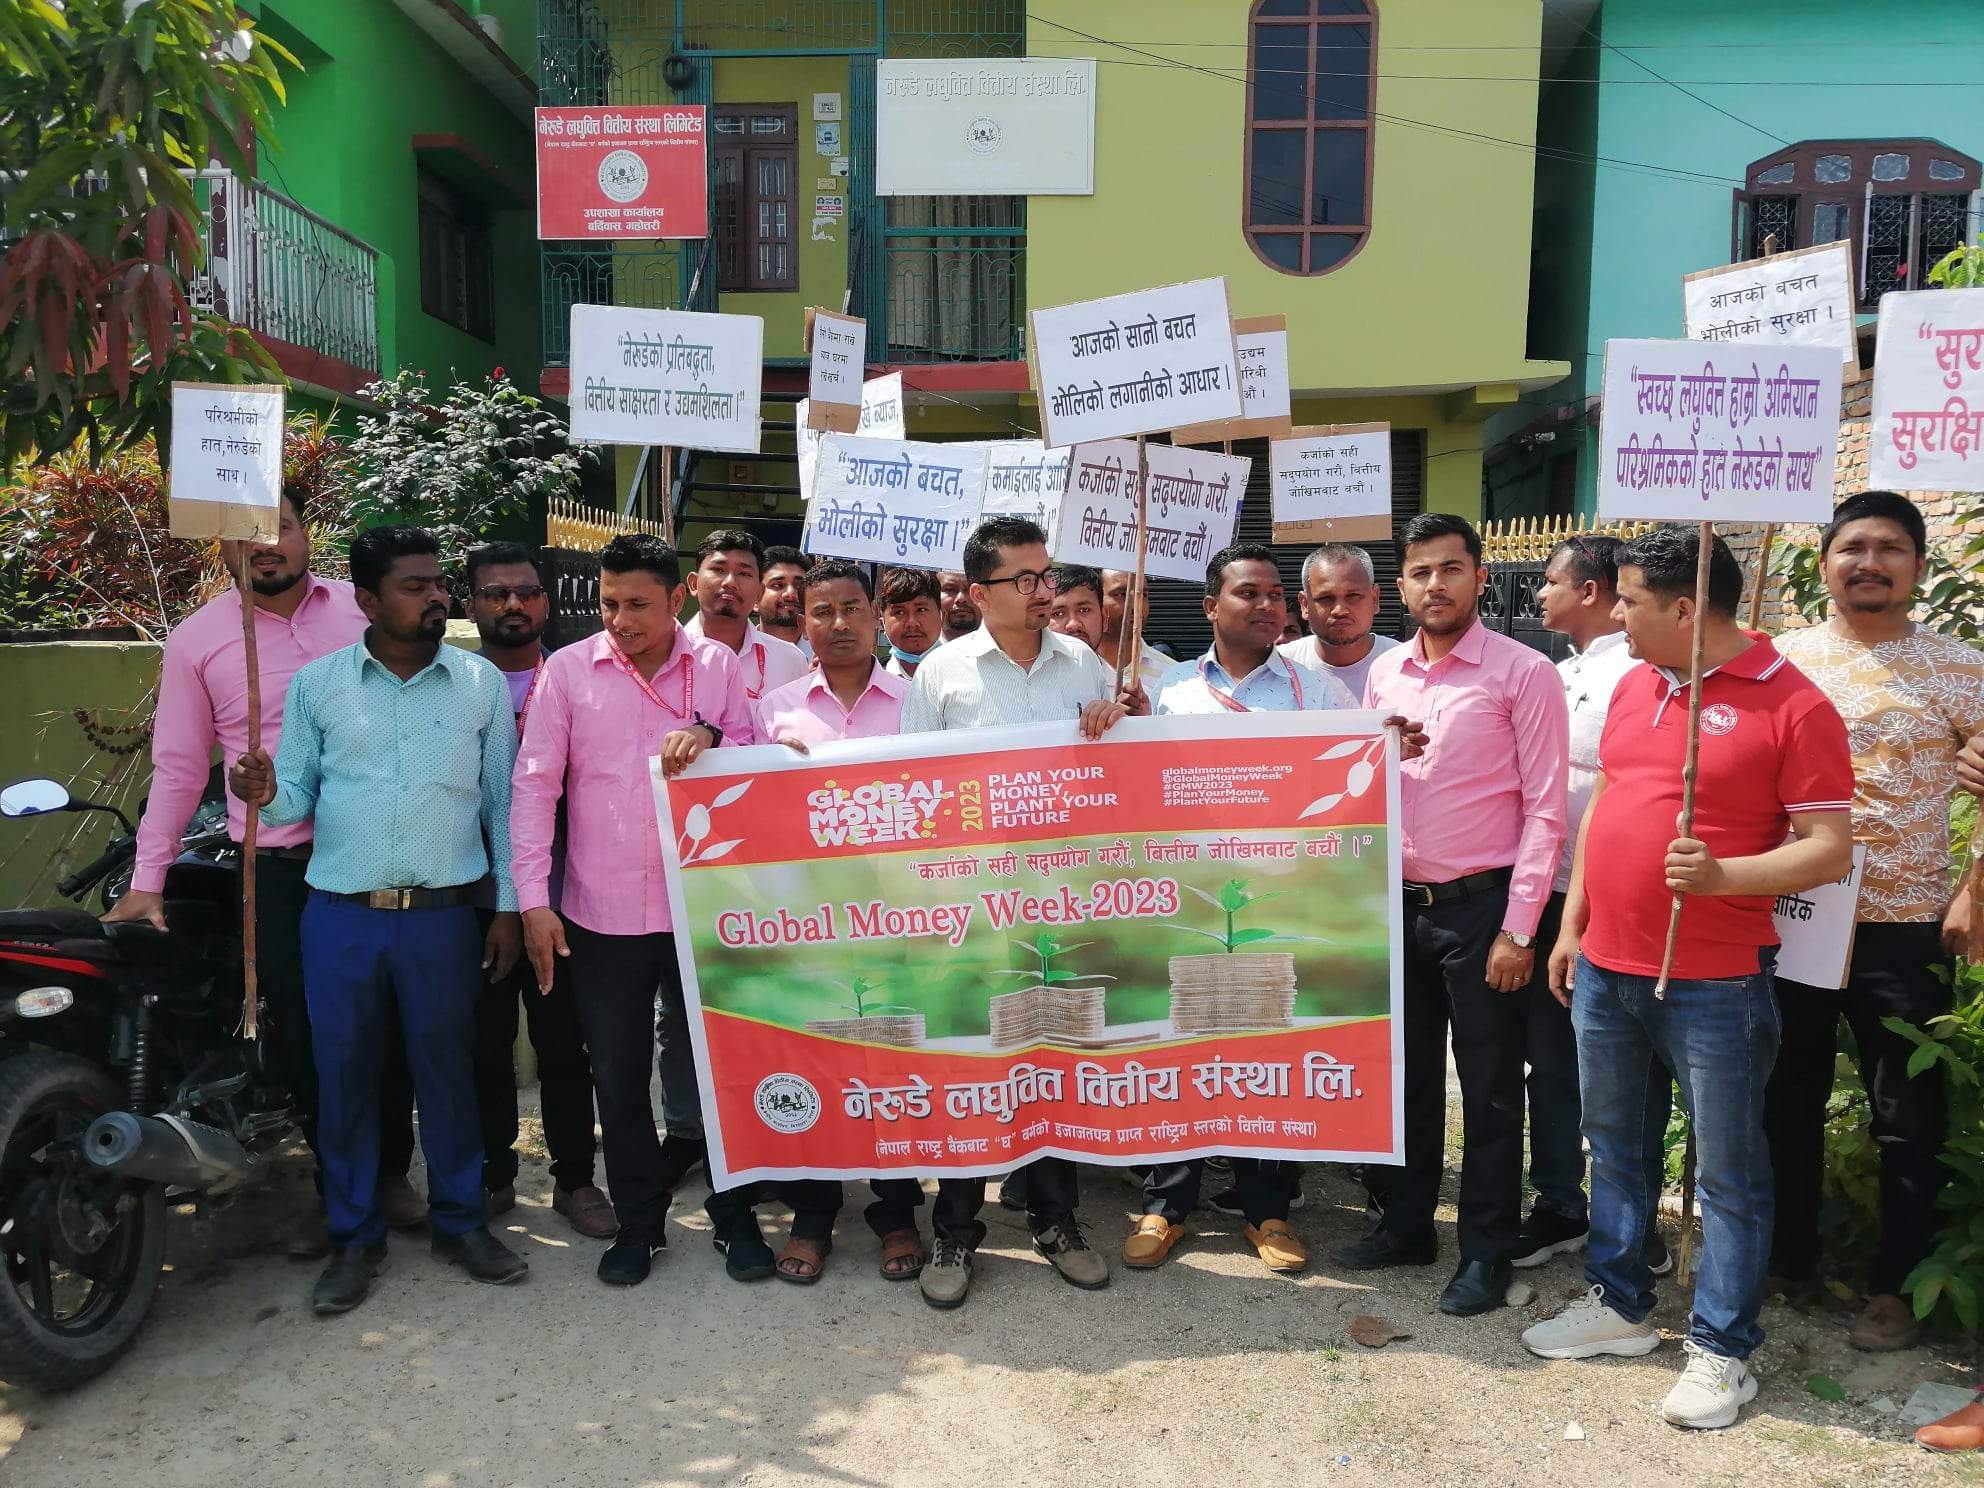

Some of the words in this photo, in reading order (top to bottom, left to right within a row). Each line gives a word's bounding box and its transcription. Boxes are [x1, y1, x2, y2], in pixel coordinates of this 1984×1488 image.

[635, 115, 661, 135] संस्था
[1710, 281, 1767, 309] आजको
[1776, 274, 1819, 295] बचत
[1069, 320, 1120, 358] आजको
[1124, 313, 1159, 348] सानो
[1163, 314, 1196, 341] बचत
[1700, 315, 1761, 342] भोलीको
[1770, 308, 1817, 335] सुरक्षा
[585, 375, 616, 413] वित्तीय
[619, 386, 661, 420] साक्षरता
[664, 389, 672, 416] र
[1051, 380, 1104, 417] भोलिको
[1108, 368, 1173, 409] लगानीको
[1177, 367, 1220, 396] आधार
[205, 405, 259, 426] परिश्रमीको
[216, 467, 239, 484] साथ
[917, 463, 964, 501] बचत,
[1350, 463, 1381, 476] वित्तीय
[818, 498, 887, 541] भोलीको
[893, 514, 949, 557] सुरक्षा
[1080, 506, 1118, 550] वित्तीय
[988, 772, 1042, 787] PLAN
[1048, 766, 1107, 782] YOUR
[1162, 764, 1293, 777] globalmoneyweek.org
[1162, 772, 1284, 784] @GlobalMoneyWeek
[1163, 781, 1233, 791] #GMW2023
[807, 779, 954, 810] GLOBAL
[959, 780, 984, 832] 2023
[989, 783, 1069, 800] MONEY,
[990, 798, 1058, 815] PLANT
[1062, 792, 1119, 809] YOUR
[1164, 788, 1265, 799] #PlanYourMoney
[1164, 796, 1270, 806] #PlantYourFuture
[809, 798, 942, 830] MONEY
[991, 810, 1070, 829] FUTURE
[987, 851, 1018, 876] सही
[1025, 846, 1091, 876] सदुपयोग
[1207, 836, 1298, 861] जोखिमबाट
[1305, 831, 1342, 857] बचौं
[717, 904, 837, 947] Global
[846, 901, 972, 946] Money
[981, 878, 1179, 930] Week-2023
[1075, 1061, 1181, 1109] वित्तीय
[1192, 1054, 1292, 1099] संस्था
[1303, 1051, 1364, 1101] लि.
[876, 1139, 911, 1158] (नेपाल
[916, 1140, 943, 1159] राष्ट्र
[948, 1135, 989, 1156] बैंकबाट
[1055, 1122, 1111, 1143] इजाजतपत्र
[1116, 1127, 1144, 1145] प्राप्त
[1193, 1115, 1233, 1136] स्तरको
[1237, 1115, 1276, 1135] वित्तीय
[1282, 1117, 1316, 1139] संस्था)
